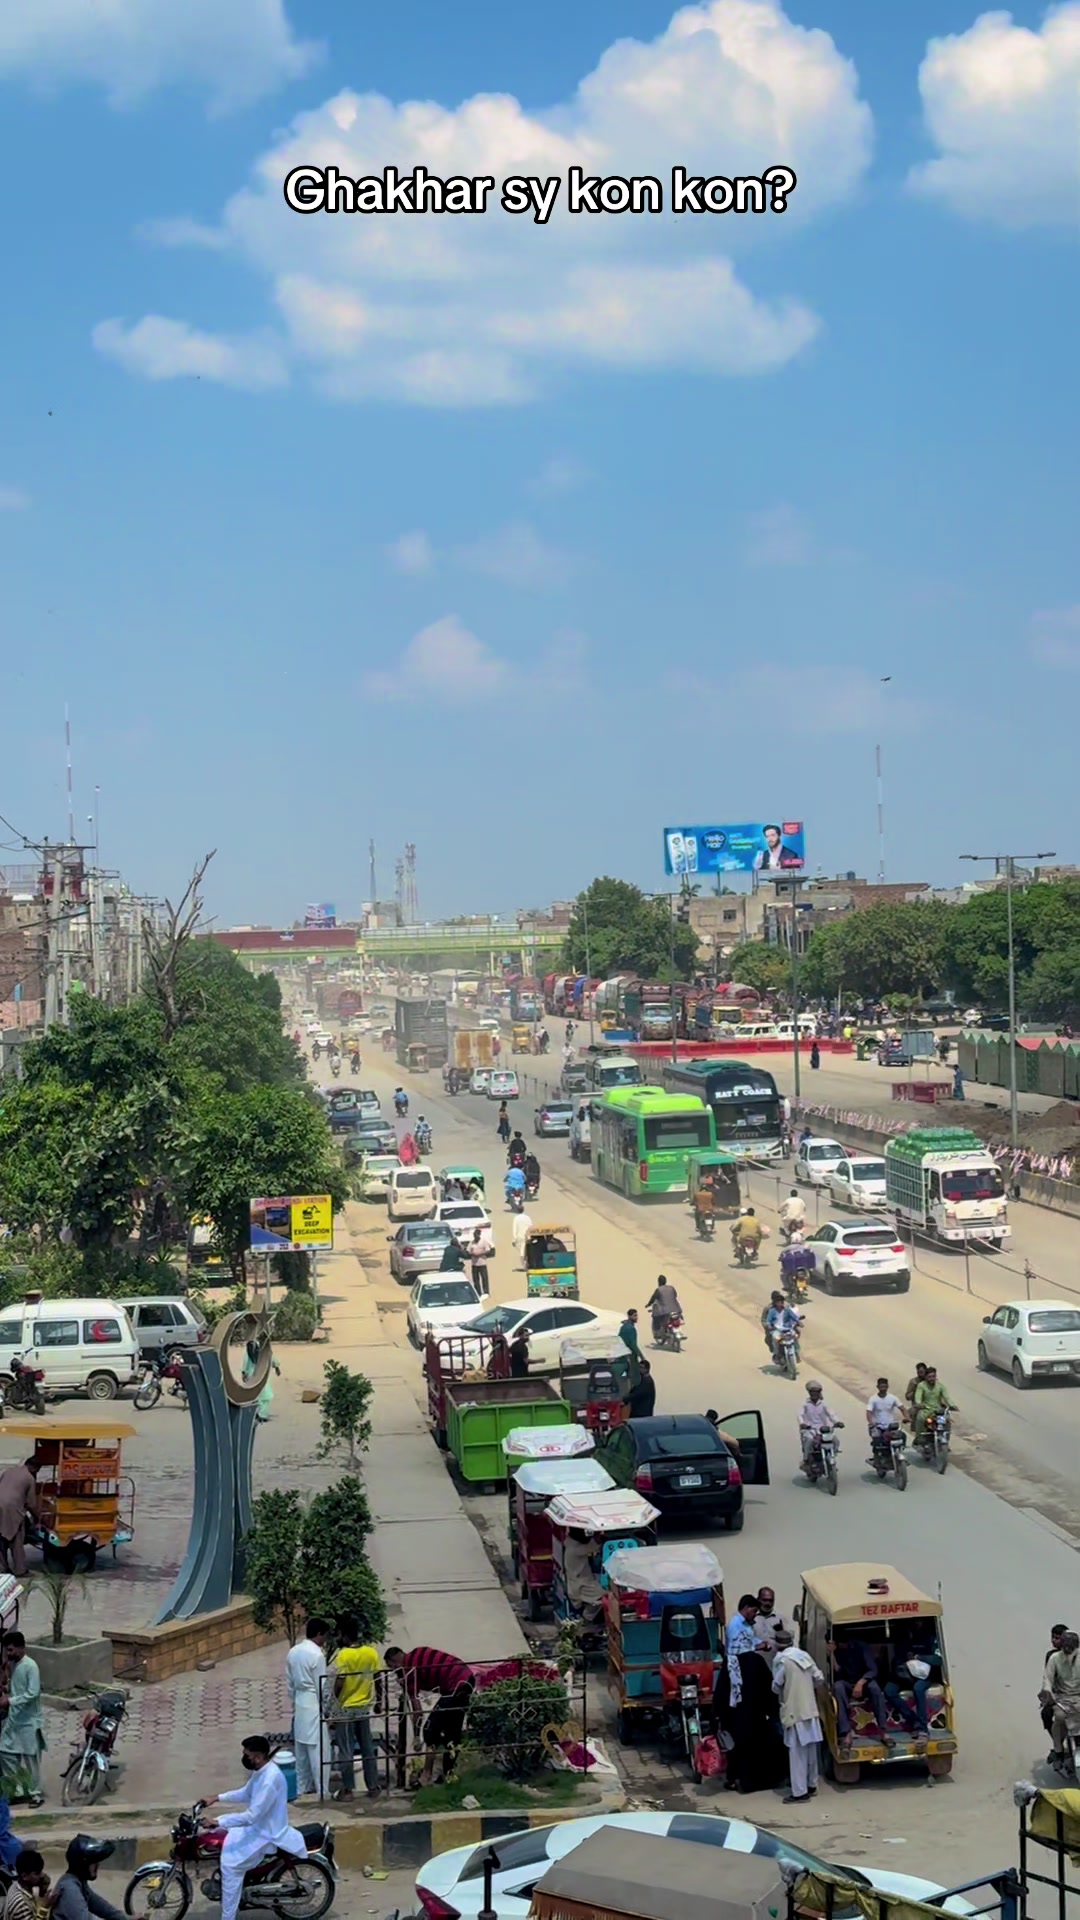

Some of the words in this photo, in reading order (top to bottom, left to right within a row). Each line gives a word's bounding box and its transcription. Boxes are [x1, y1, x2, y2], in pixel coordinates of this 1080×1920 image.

[742, 1088, 773, 1097] COACH
[861, 1605, 878, 1616] TEZ
[880, 1602, 919, 1615] RAFTAR
